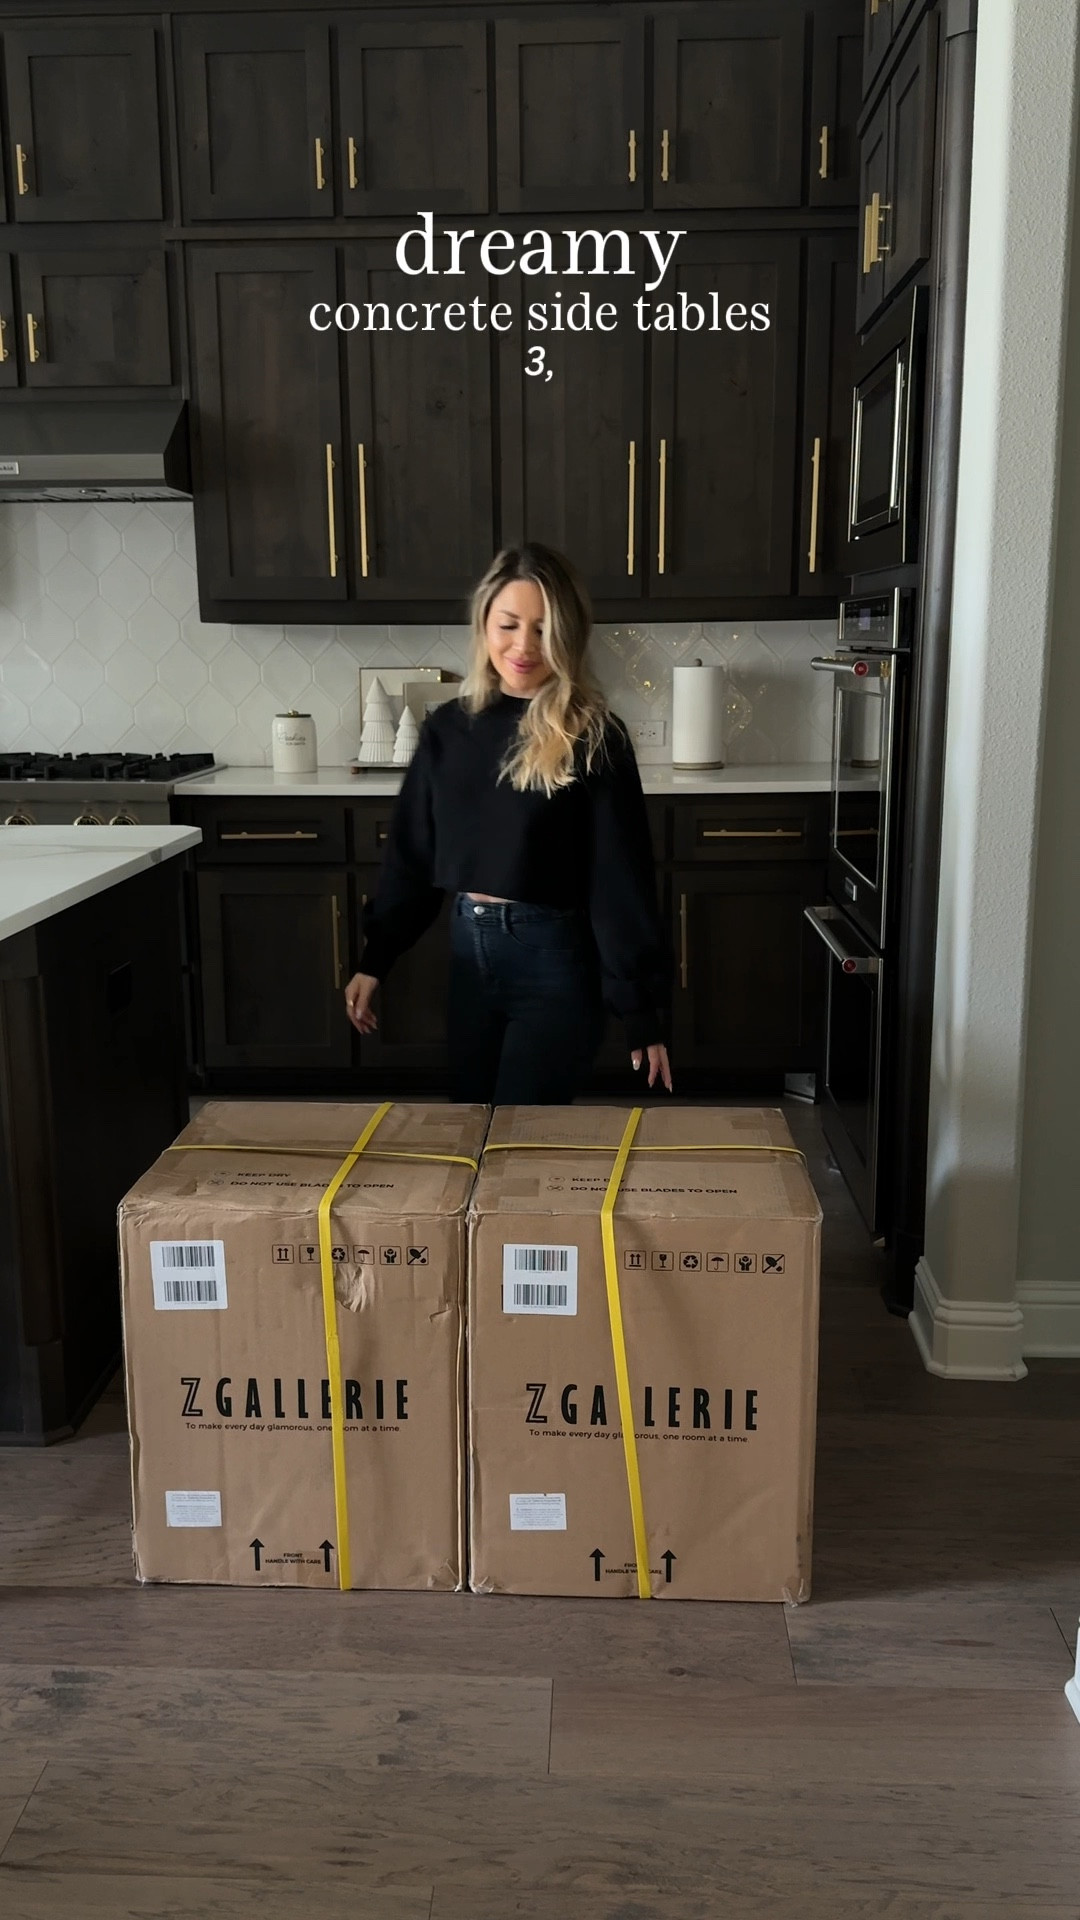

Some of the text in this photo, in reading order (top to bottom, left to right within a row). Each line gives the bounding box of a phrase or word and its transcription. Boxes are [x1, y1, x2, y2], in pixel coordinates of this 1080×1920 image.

[180, 1377, 409, 1420] Z GALLERIE
[525, 1383, 758, 1431] Z GALERIE
[185, 1422, 196, 1430] To
[224, 1424, 247, 1432] every
[249, 1423, 265, 1432] day
[529, 1428, 540, 1437] To
[542, 1429, 567, 1437] make
[568, 1430, 593, 1440] every
[594, 1430, 610, 1440] day
[612, 1431, 661, 1441] glaorous,
[707, 1434, 717, 1442] at
